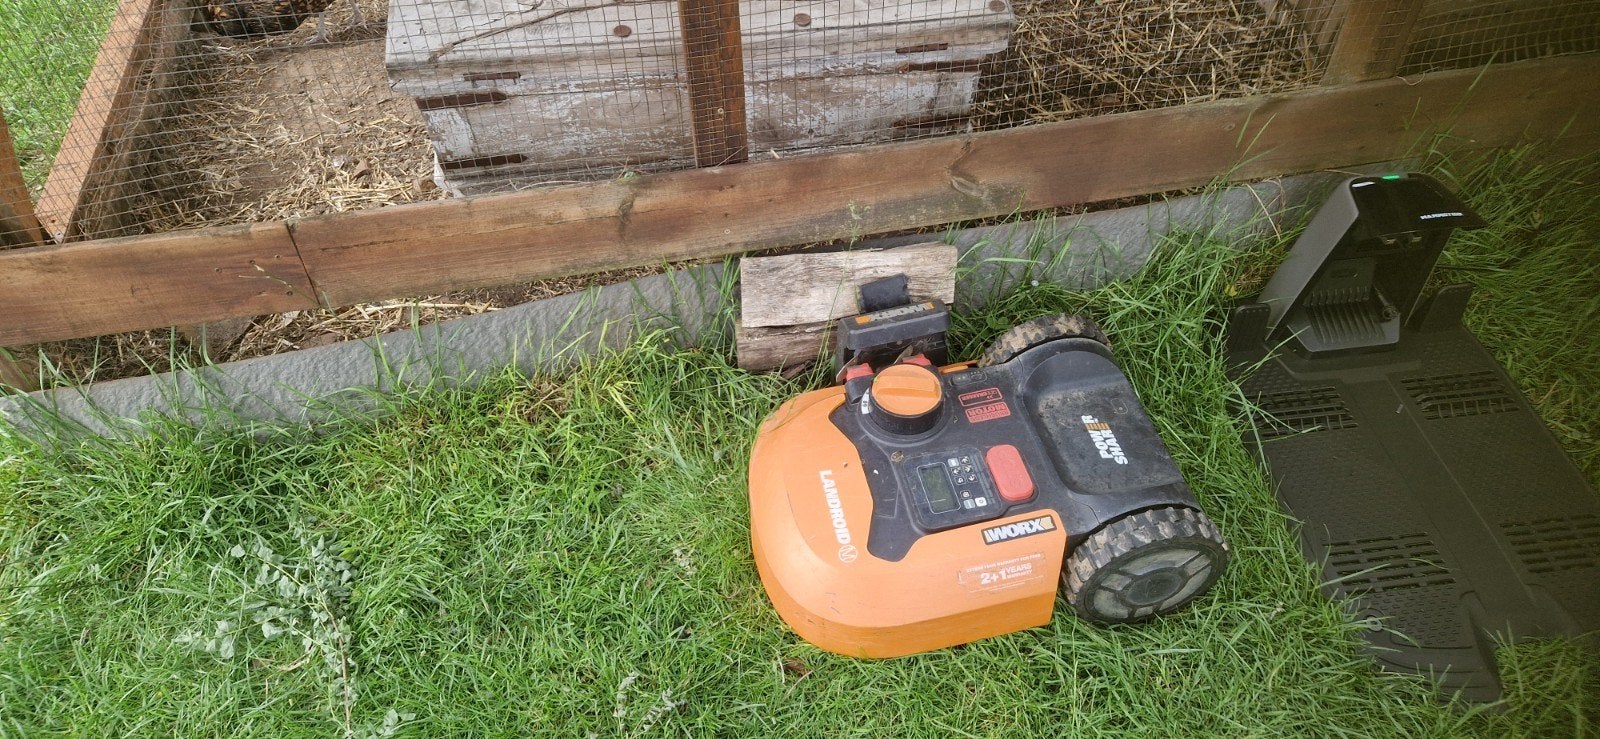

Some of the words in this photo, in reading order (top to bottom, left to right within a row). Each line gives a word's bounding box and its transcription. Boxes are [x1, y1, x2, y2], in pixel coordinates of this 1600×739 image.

[1081, 415, 1114, 459] POWER
[1098, 422, 1129, 465] SHARE
[819, 470, 851, 545] LANDROID
[986, 517, 1046, 542] WORX
[980, 568, 1007, 585] 2+1
[1006, 562, 1032, 574] YEARS
